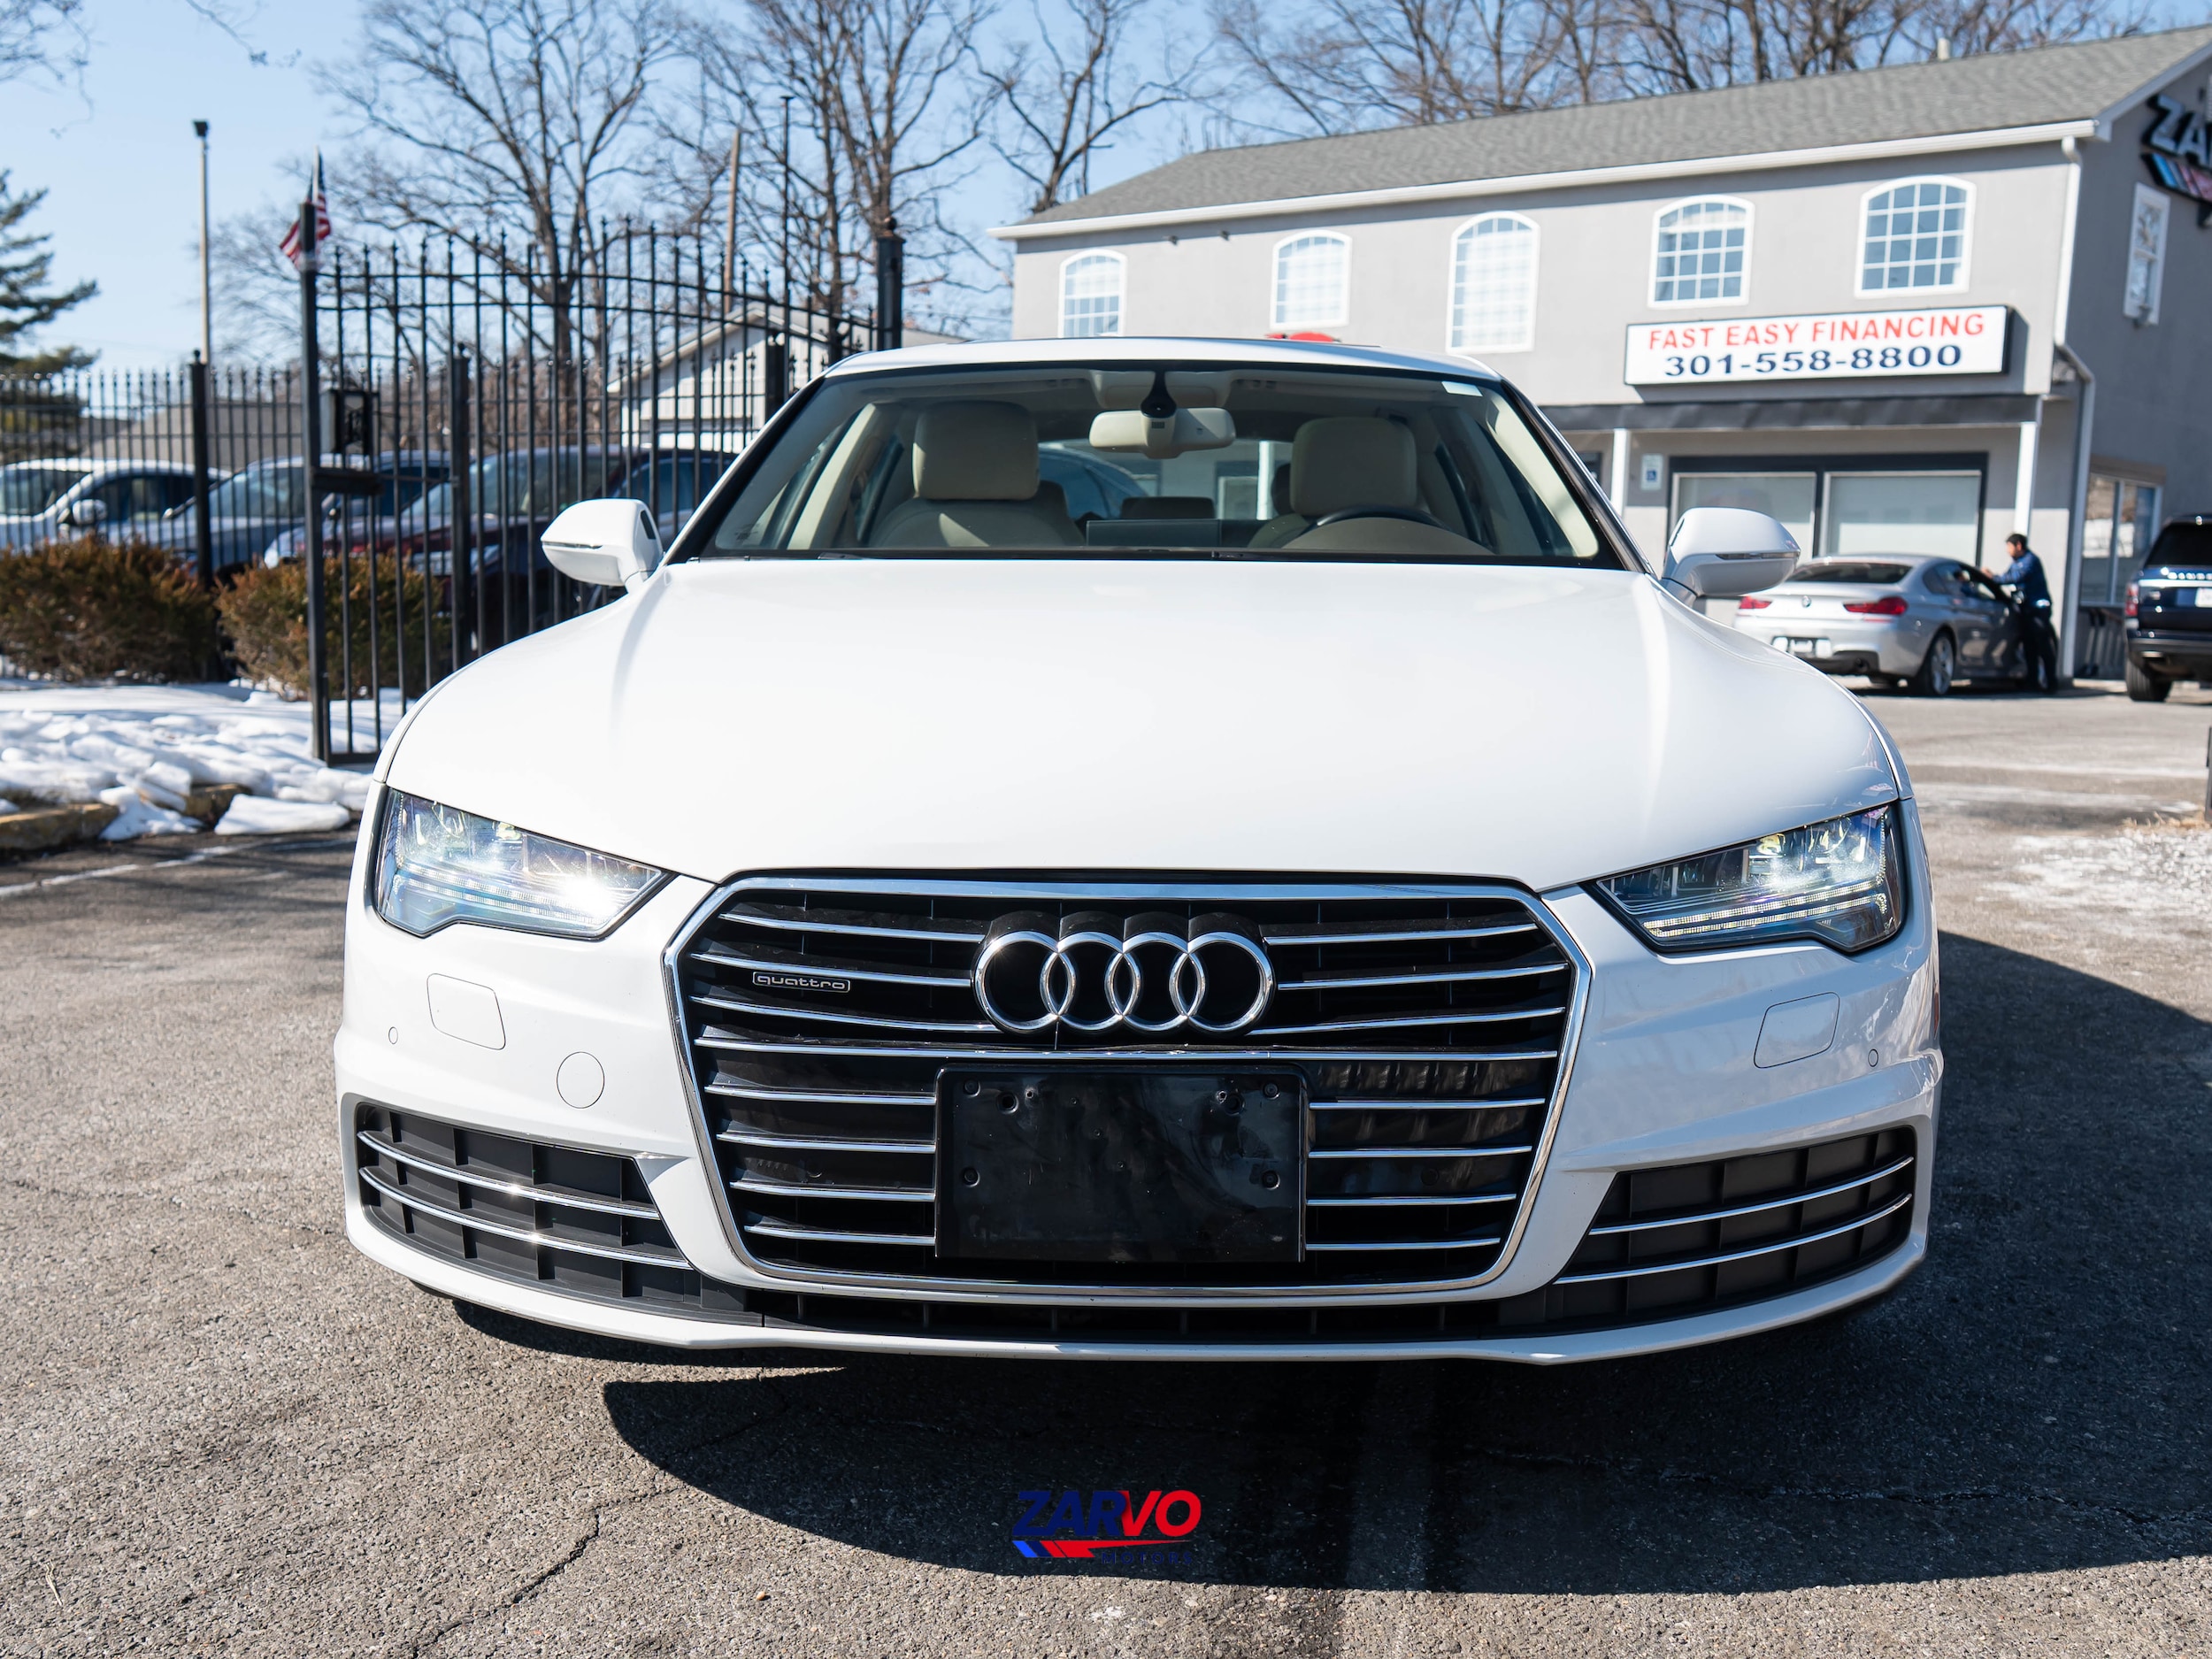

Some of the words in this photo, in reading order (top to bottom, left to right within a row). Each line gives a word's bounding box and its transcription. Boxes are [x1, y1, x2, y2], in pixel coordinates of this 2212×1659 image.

[2141, 93, 2212, 168] ZA
[1649, 327, 1714, 349] FAST
[1726, 322, 1799, 346] EASY
[1812, 313, 1984, 342] FINANCING
[1665, 344, 1962, 377] 301-558-8800
[757, 975, 846, 990] quattro
